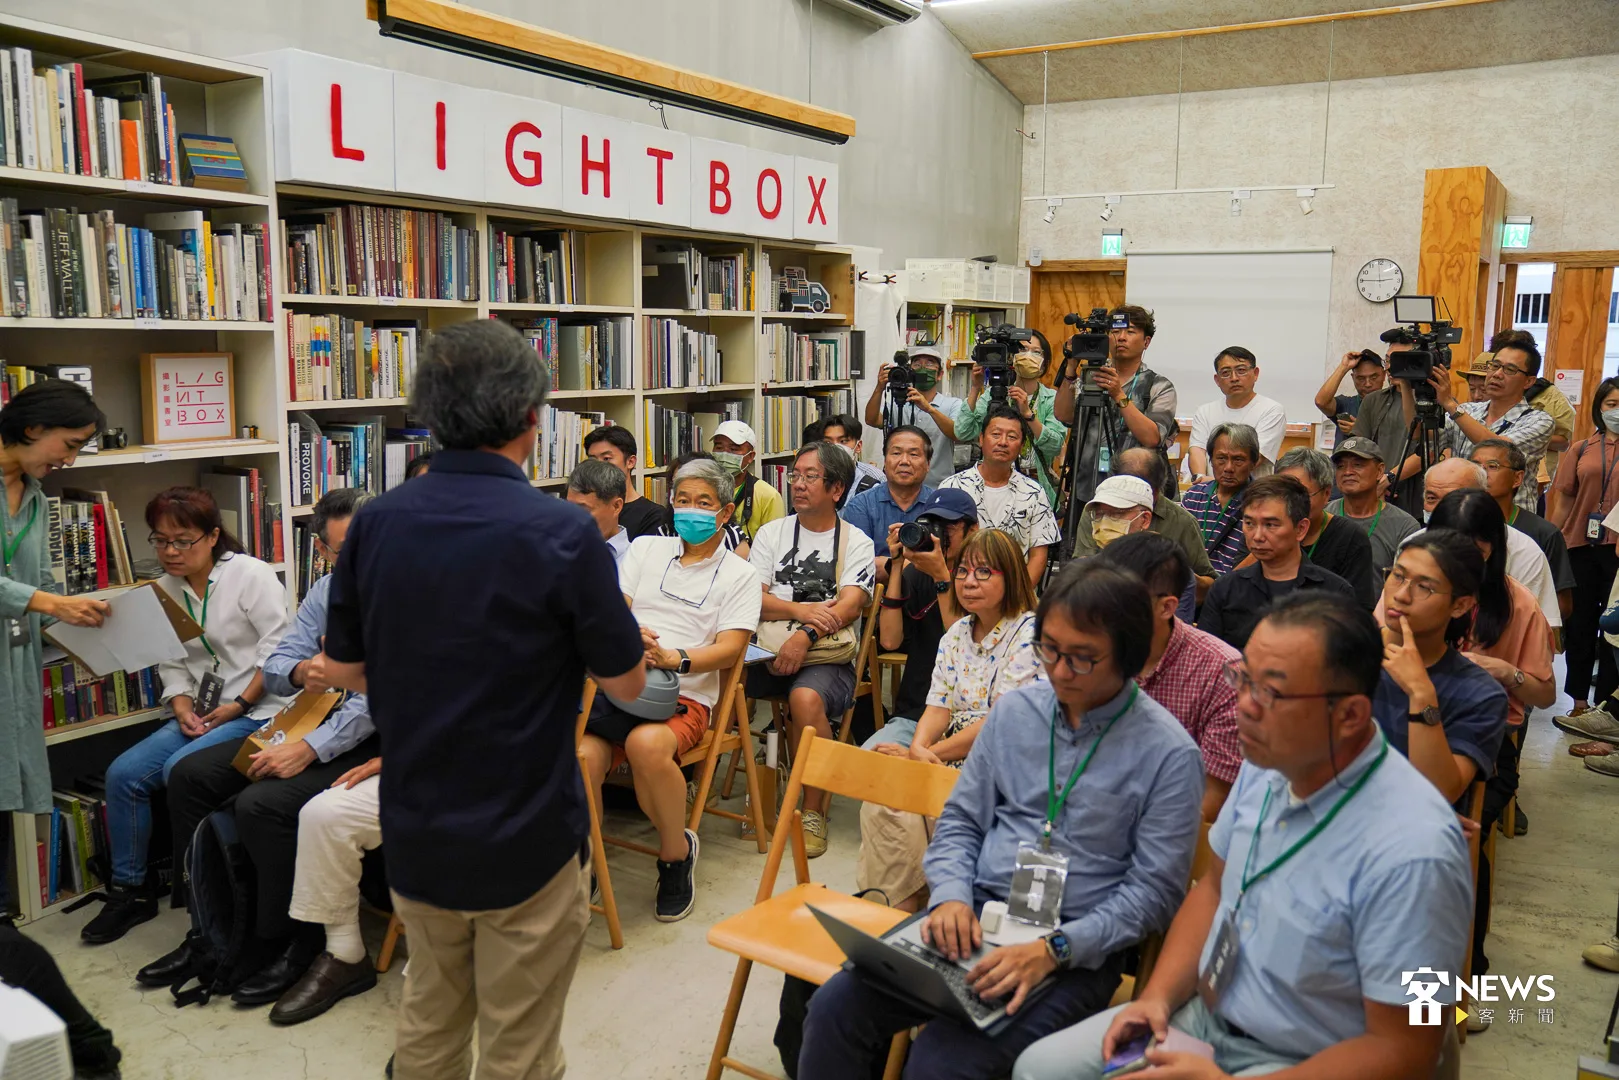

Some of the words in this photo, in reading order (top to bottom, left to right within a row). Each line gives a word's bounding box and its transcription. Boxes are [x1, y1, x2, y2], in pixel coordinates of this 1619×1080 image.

[57, 228, 71, 257] JEFF
[60, 259, 73, 294] WALL
[301, 442, 311, 495] PROVOKE
[47, 498, 63, 563] MAGNUM
[64, 524, 73, 567] MAGNUM
[72, 523, 80, 566] MAGNUM
[79, 522, 89, 565] MAGNUM
[87, 521, 97, 563] MAGNUM
